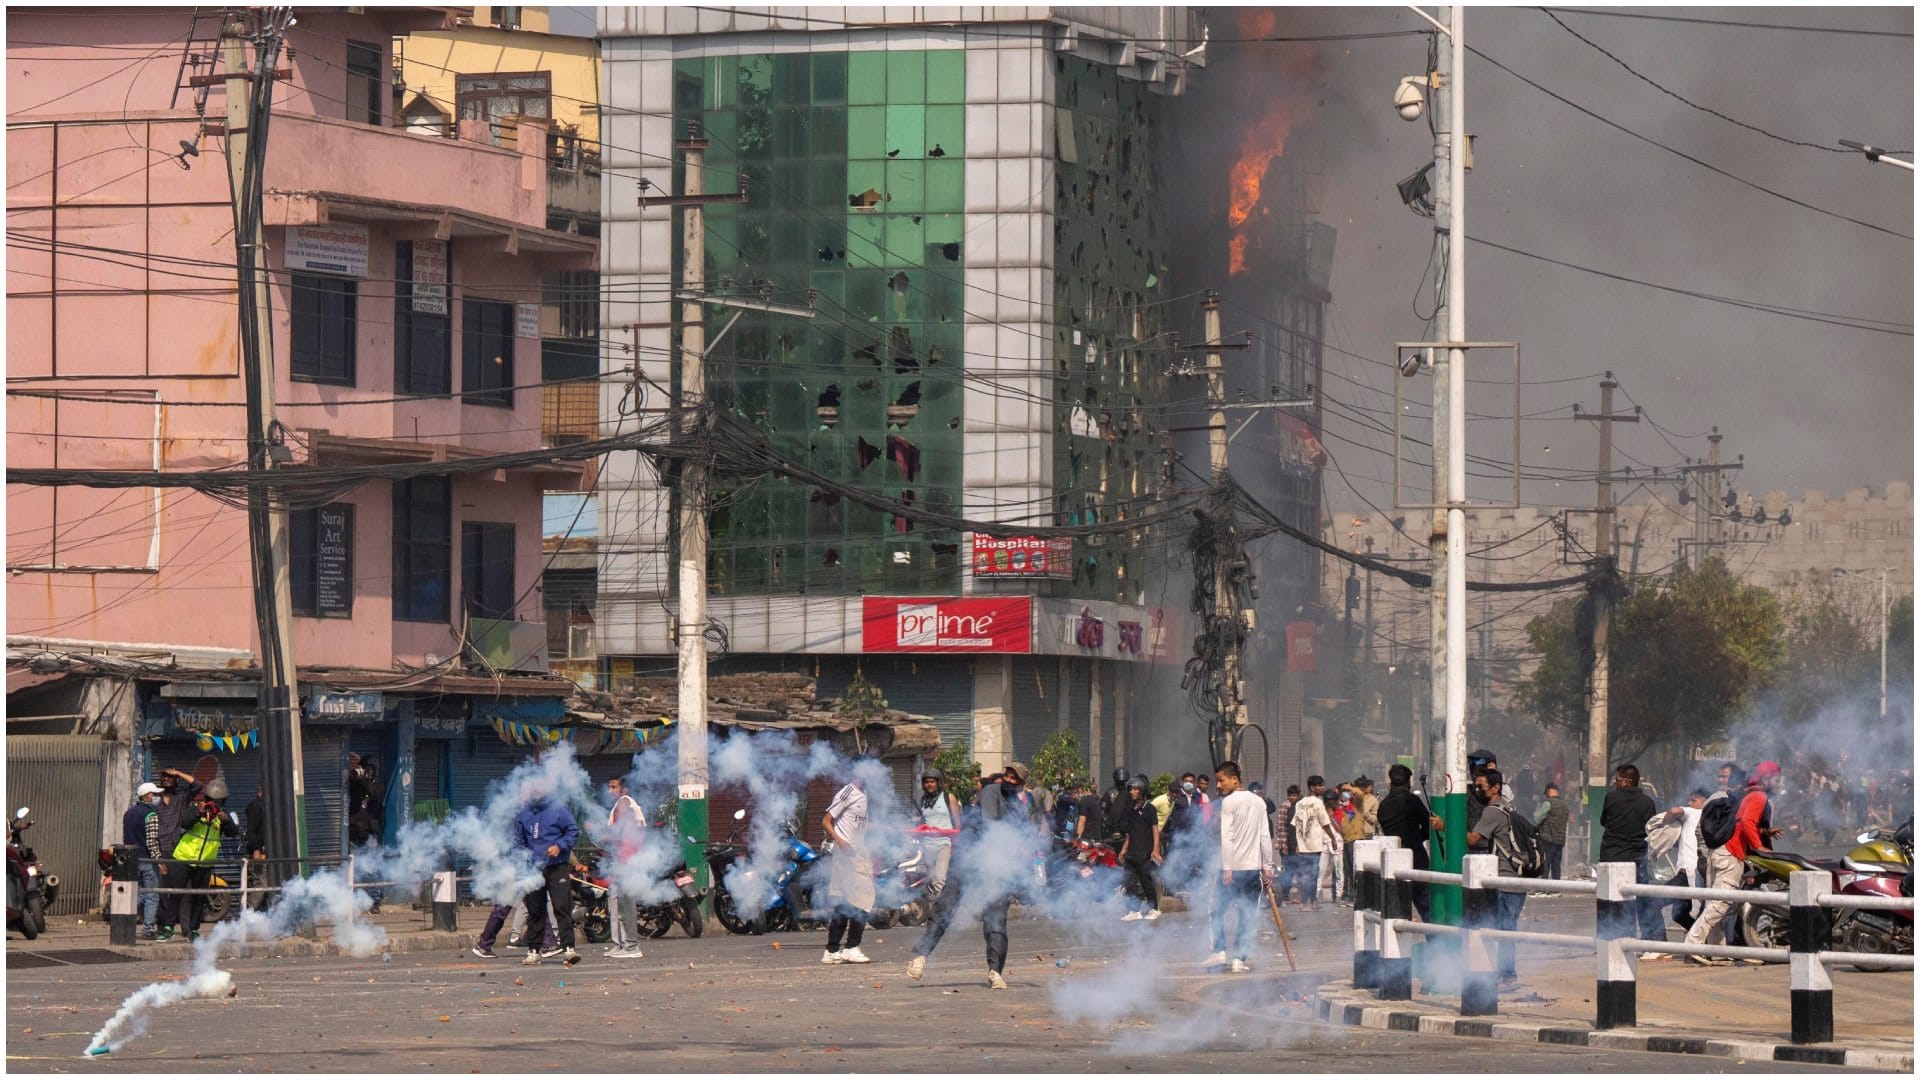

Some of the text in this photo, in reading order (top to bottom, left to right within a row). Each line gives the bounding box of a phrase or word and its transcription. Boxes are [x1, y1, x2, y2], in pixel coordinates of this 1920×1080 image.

[321, 510, 345, 532] Suraj
[325, 529, 341, 543] Art
[320, 543, 346, 555] Service
[975, 538, 1046, 550] Hospital
[901, 611, 993, 639] prime
